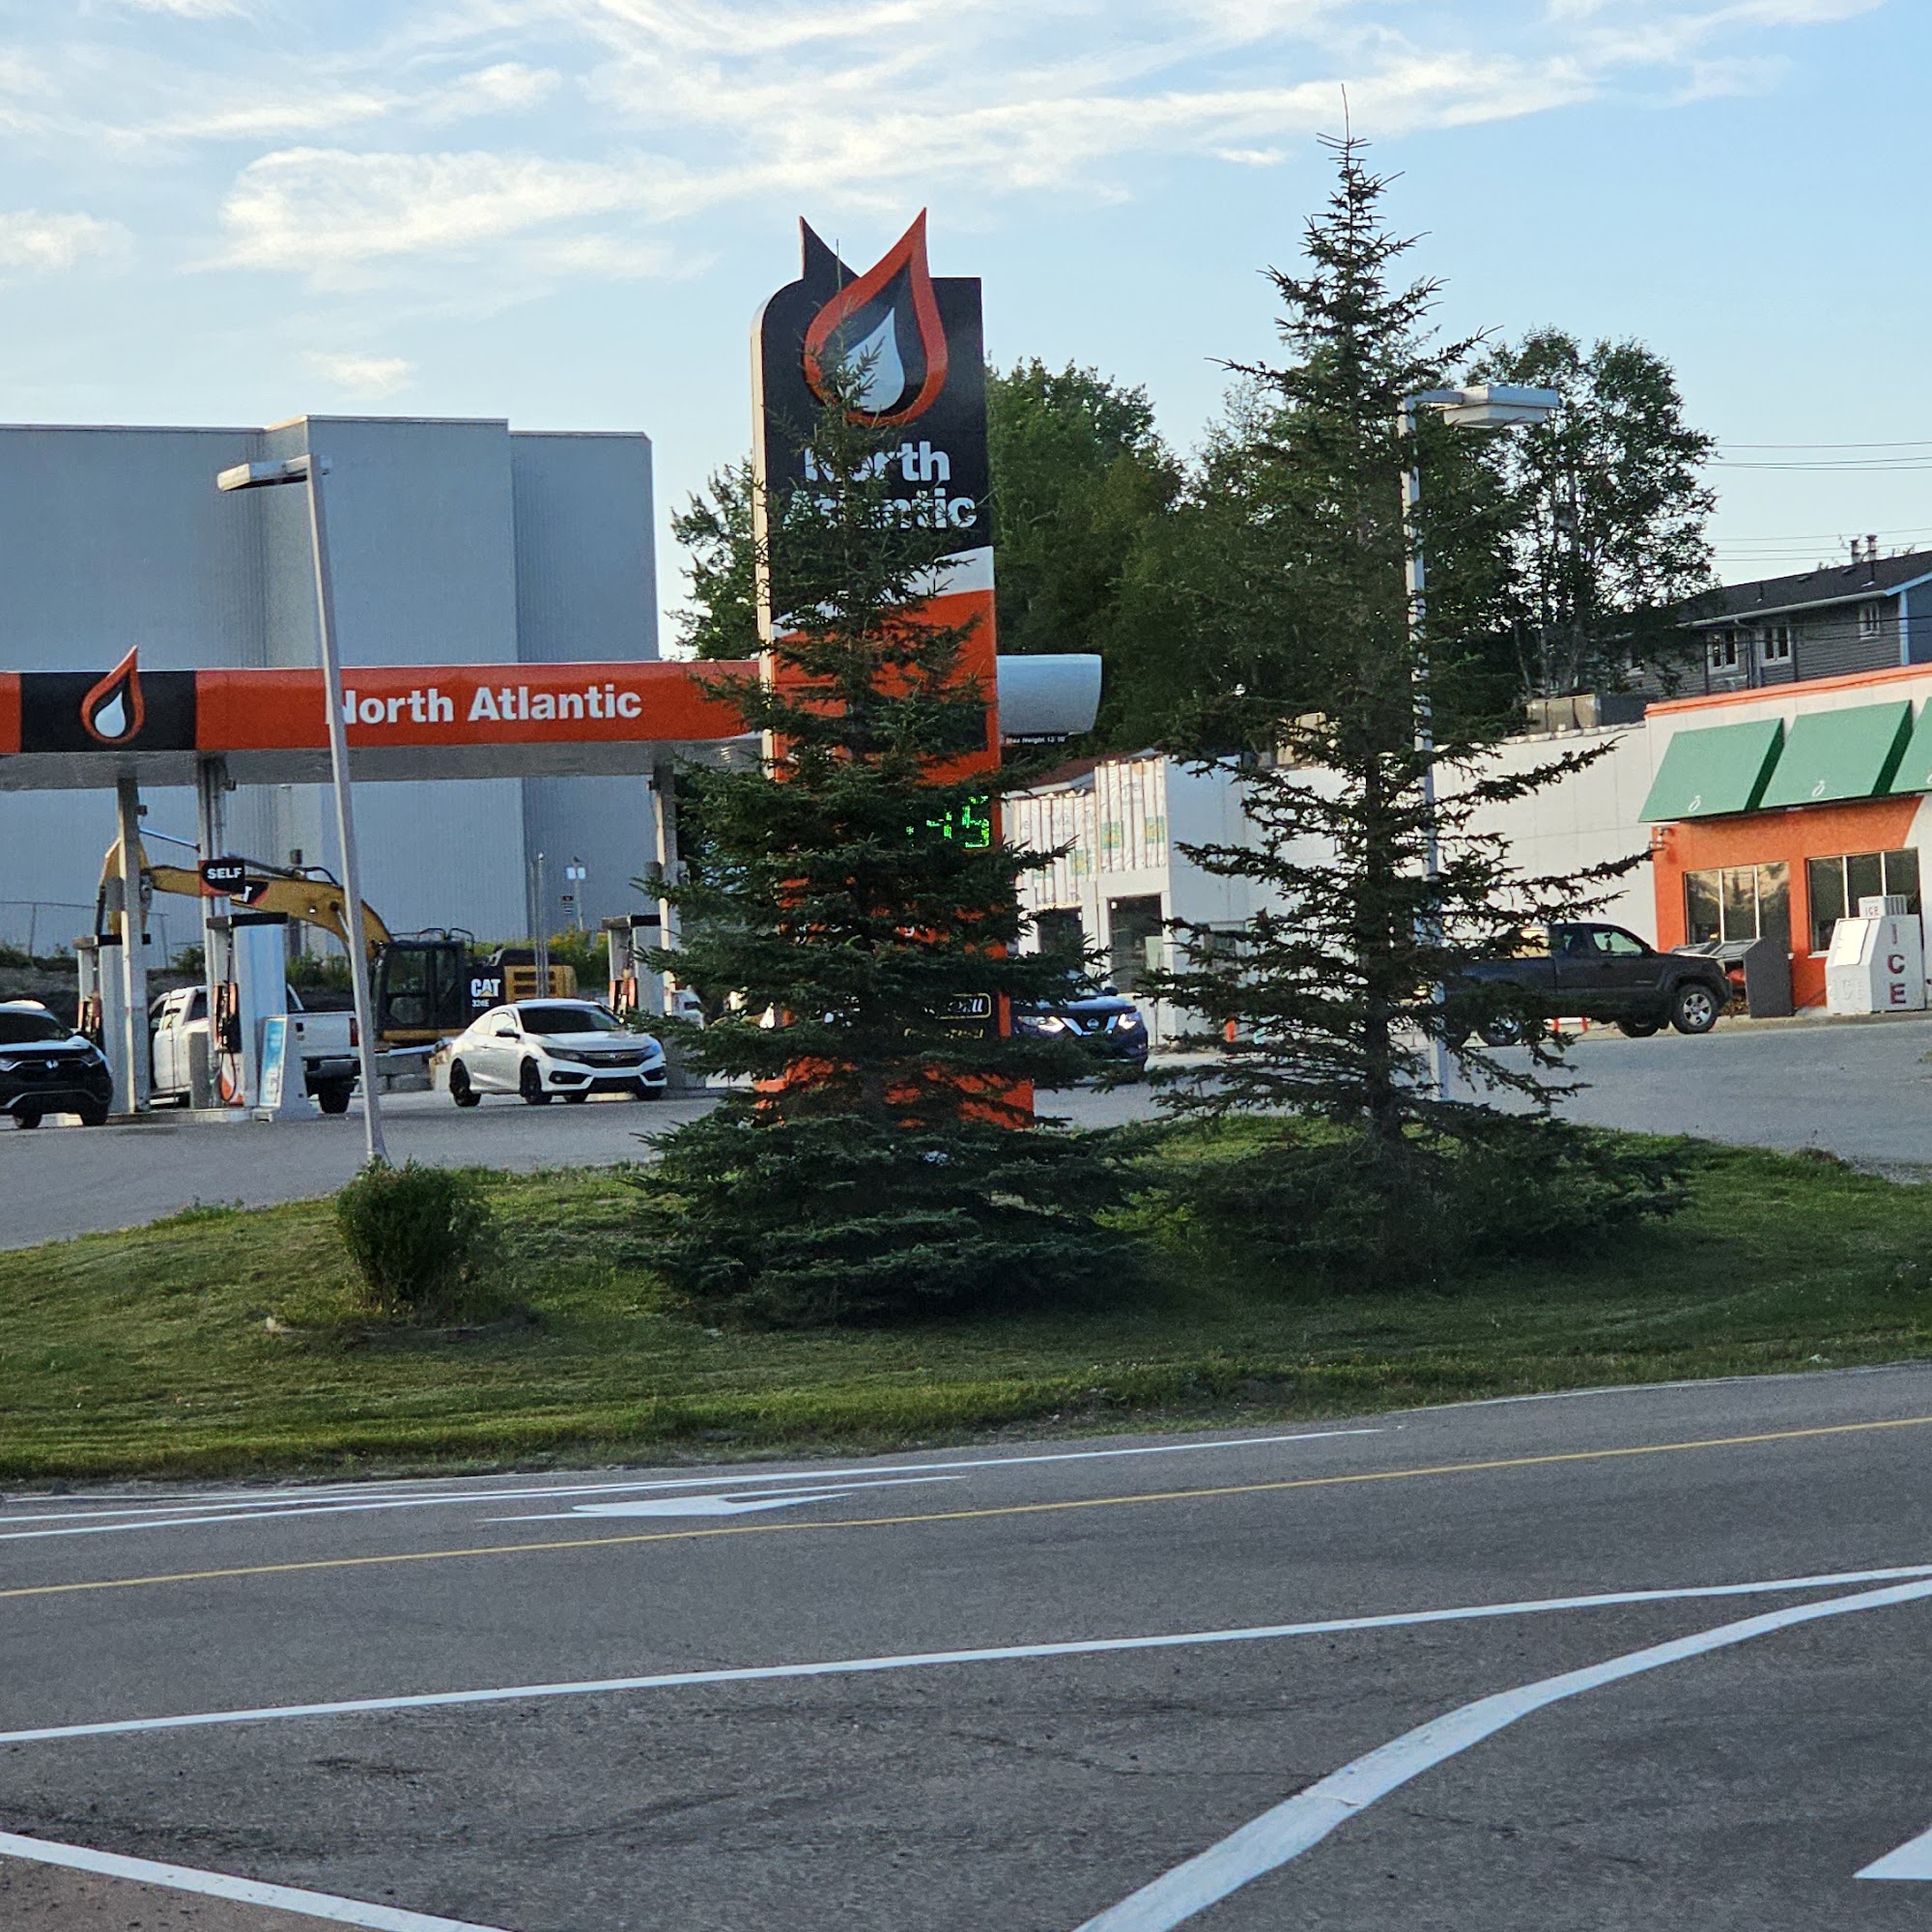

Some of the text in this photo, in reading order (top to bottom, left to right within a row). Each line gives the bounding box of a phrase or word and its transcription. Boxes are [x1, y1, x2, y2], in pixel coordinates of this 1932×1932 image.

[468, 684, 642, 722] Atlantic
[207, 867, 242, 879] SELF
[1887, 923, 1907, 1006] ICE
[470, 979, 501, 998] CAT
